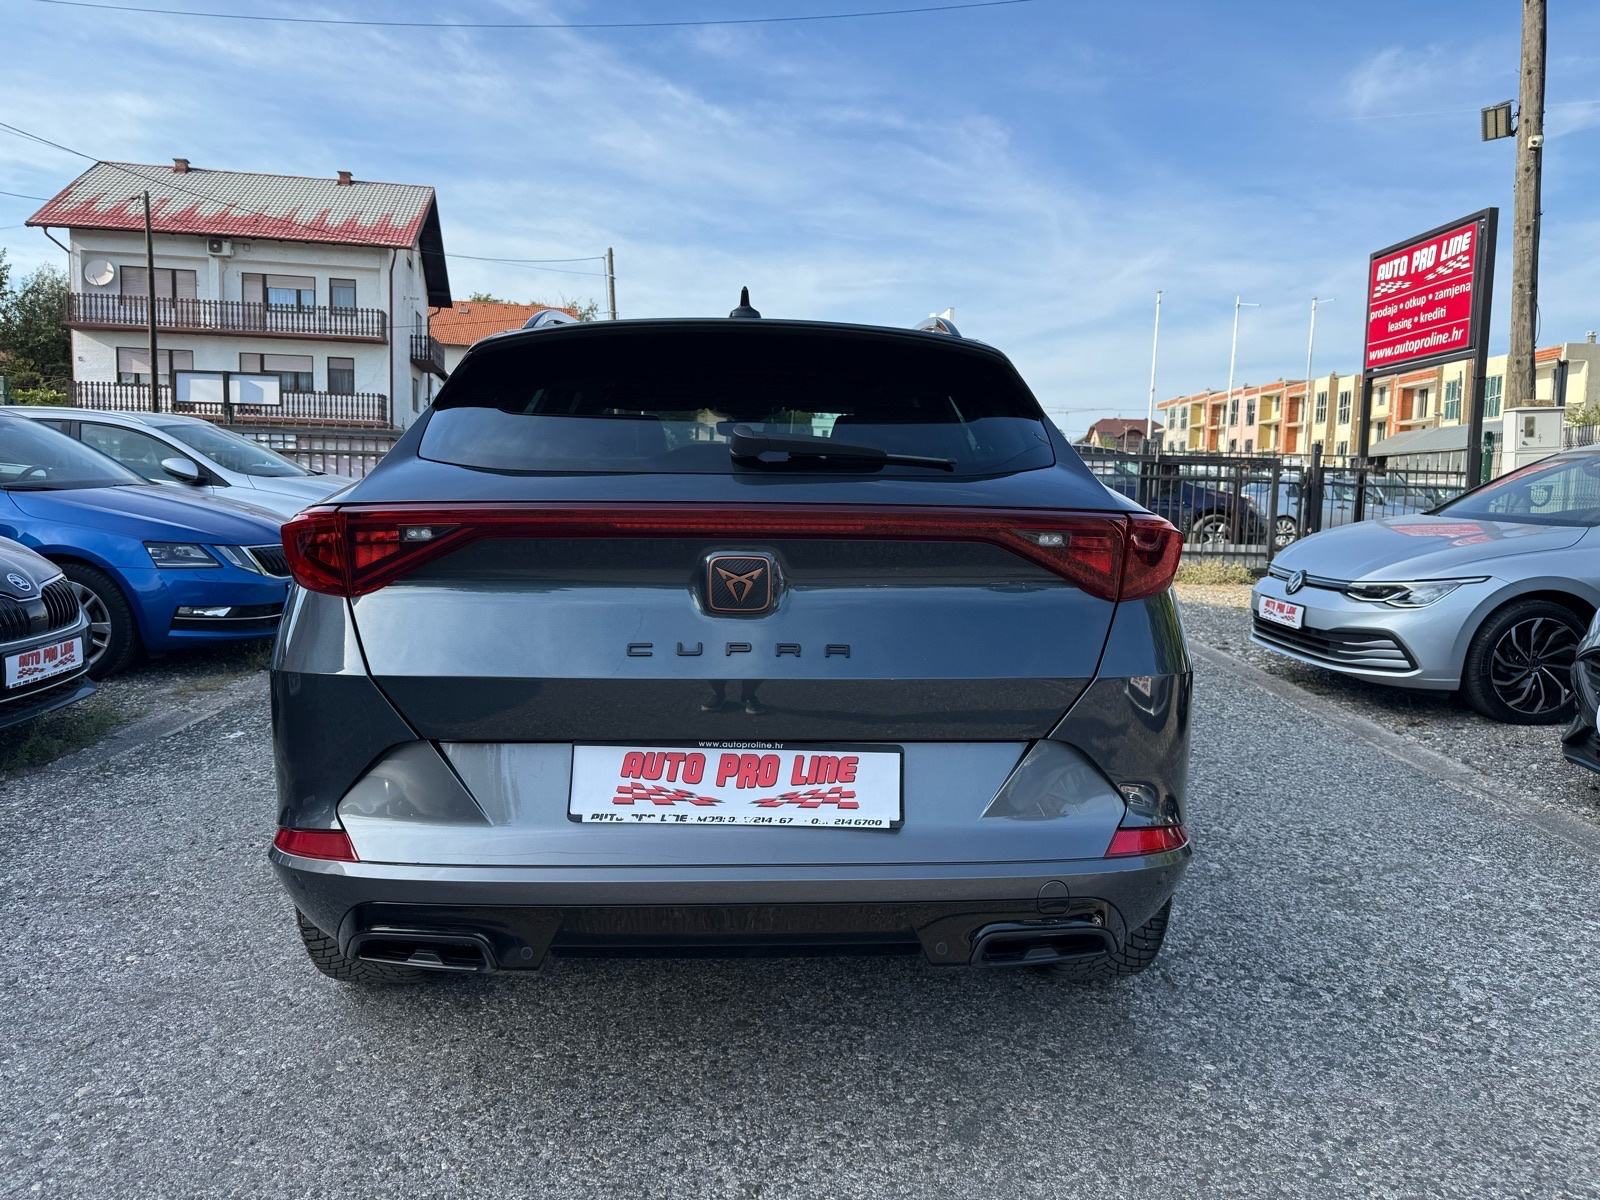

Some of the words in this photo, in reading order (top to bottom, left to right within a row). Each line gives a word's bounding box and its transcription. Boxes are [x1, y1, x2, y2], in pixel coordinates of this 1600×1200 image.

[1376, 255, 1408, 281] AUTO
[1411, 244, 1437, 274] PRO
[1440, 231, 1472, 262] LINE
[1370, 304, 1398, 322] prodaja
[1405, 295, 1426, 311] otkup
[1434, 282, 1471, 301] zamjena
[1388, 317, 1412, 332] leasing
[1419, 306, 1446, 323] krediti
[1369, 327, 1464, 361] www.autoproline.hr
[19, 651, 40, 667] AUTO
[44, 646, 58, 663] PRO
[61, 642, 74, 657] LINE
[626, 641, 851, 658] CUPRA
[698, 741, 784, 749] www.autoproline.hr
[620, 752, 706, 784] AUTO
[716, 753, 781, 789] PRO
[790, 755, 859, 786] LINE
